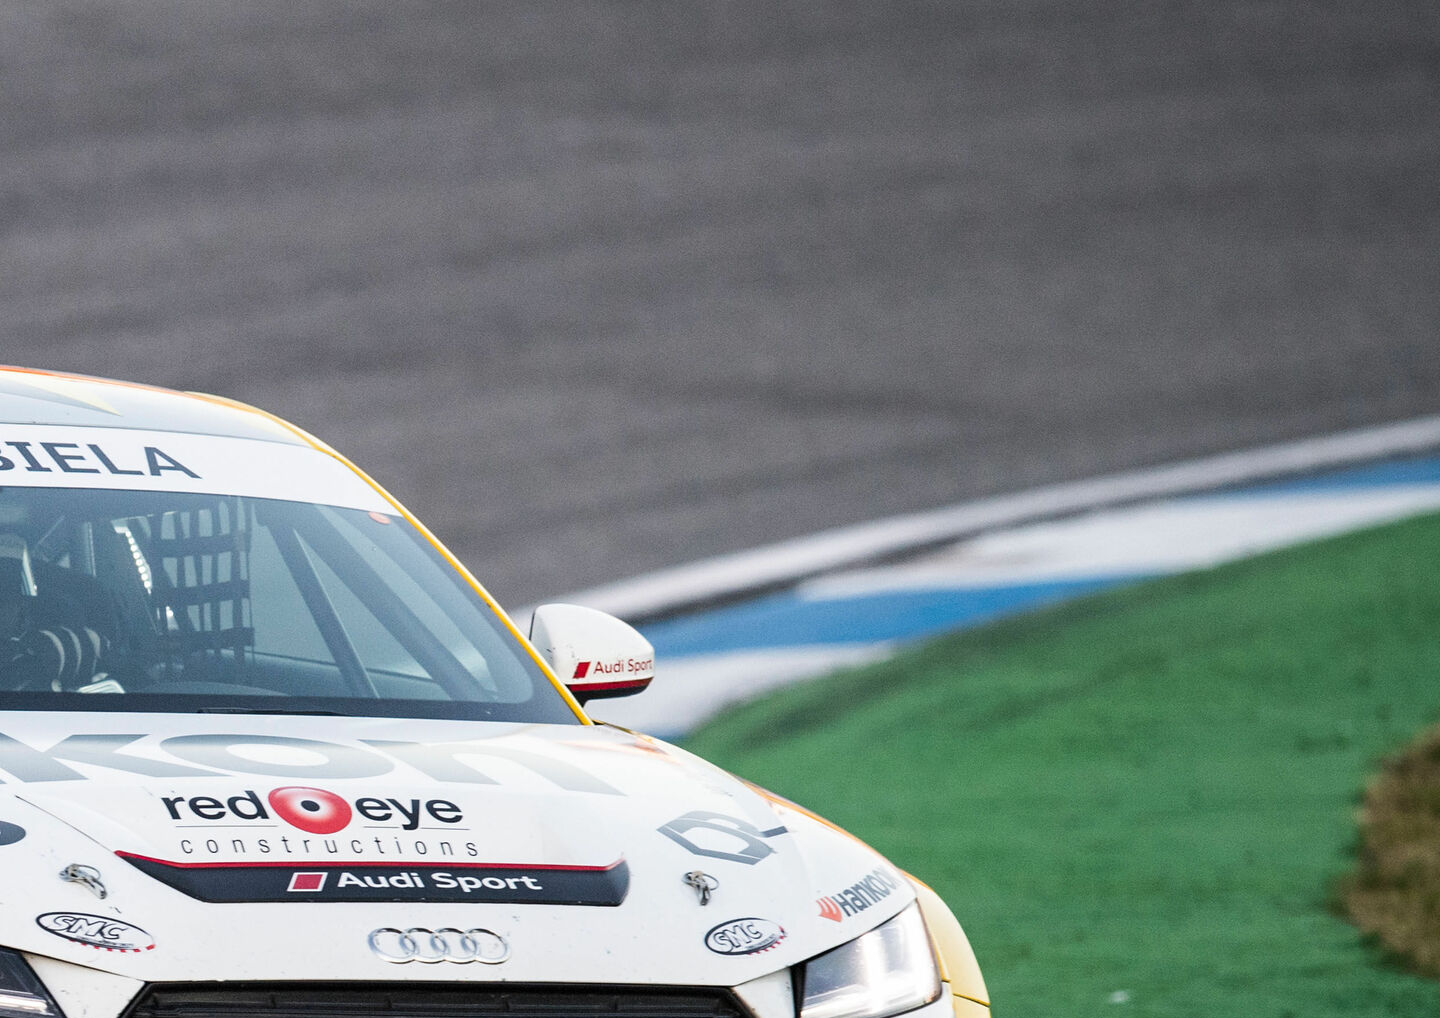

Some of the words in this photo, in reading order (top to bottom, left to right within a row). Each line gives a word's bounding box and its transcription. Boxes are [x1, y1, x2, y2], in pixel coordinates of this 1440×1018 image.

[593, 660, 625, 674] Audi
[627, 658, 653, 675] Sport
[160, 789, 269, 821] red
[356, 797, 464, 831] eye
[180, 836, 479, 858] constructions
[338, 872, 423, 888] Audi
[436, 873, 543, 893] Sport
